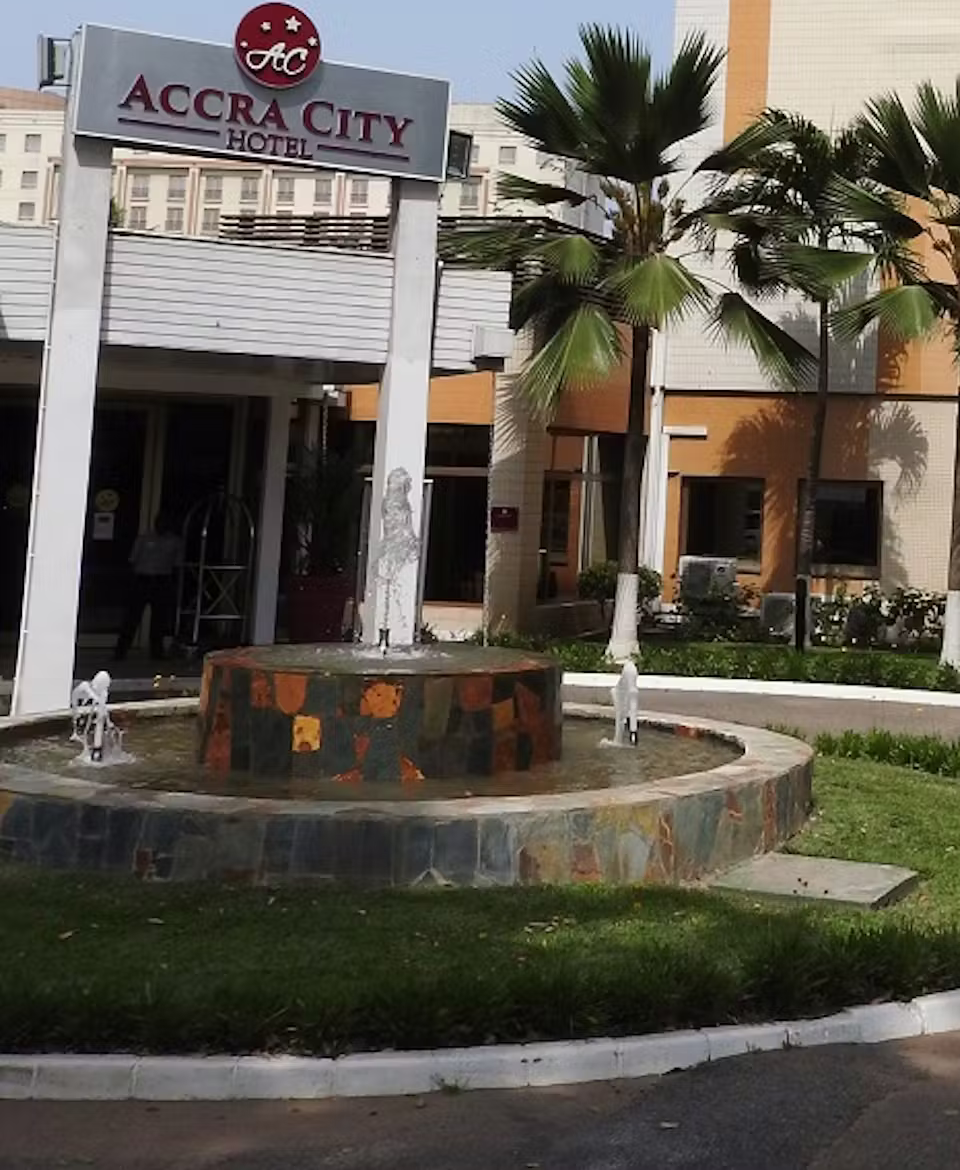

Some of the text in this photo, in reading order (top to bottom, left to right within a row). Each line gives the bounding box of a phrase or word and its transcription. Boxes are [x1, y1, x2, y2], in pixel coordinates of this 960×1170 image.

[247, 42, 307, 76] AC
[118, 73, 414, 148] ACCRA CITY
[226, 131, 312, 160] HOTEL
